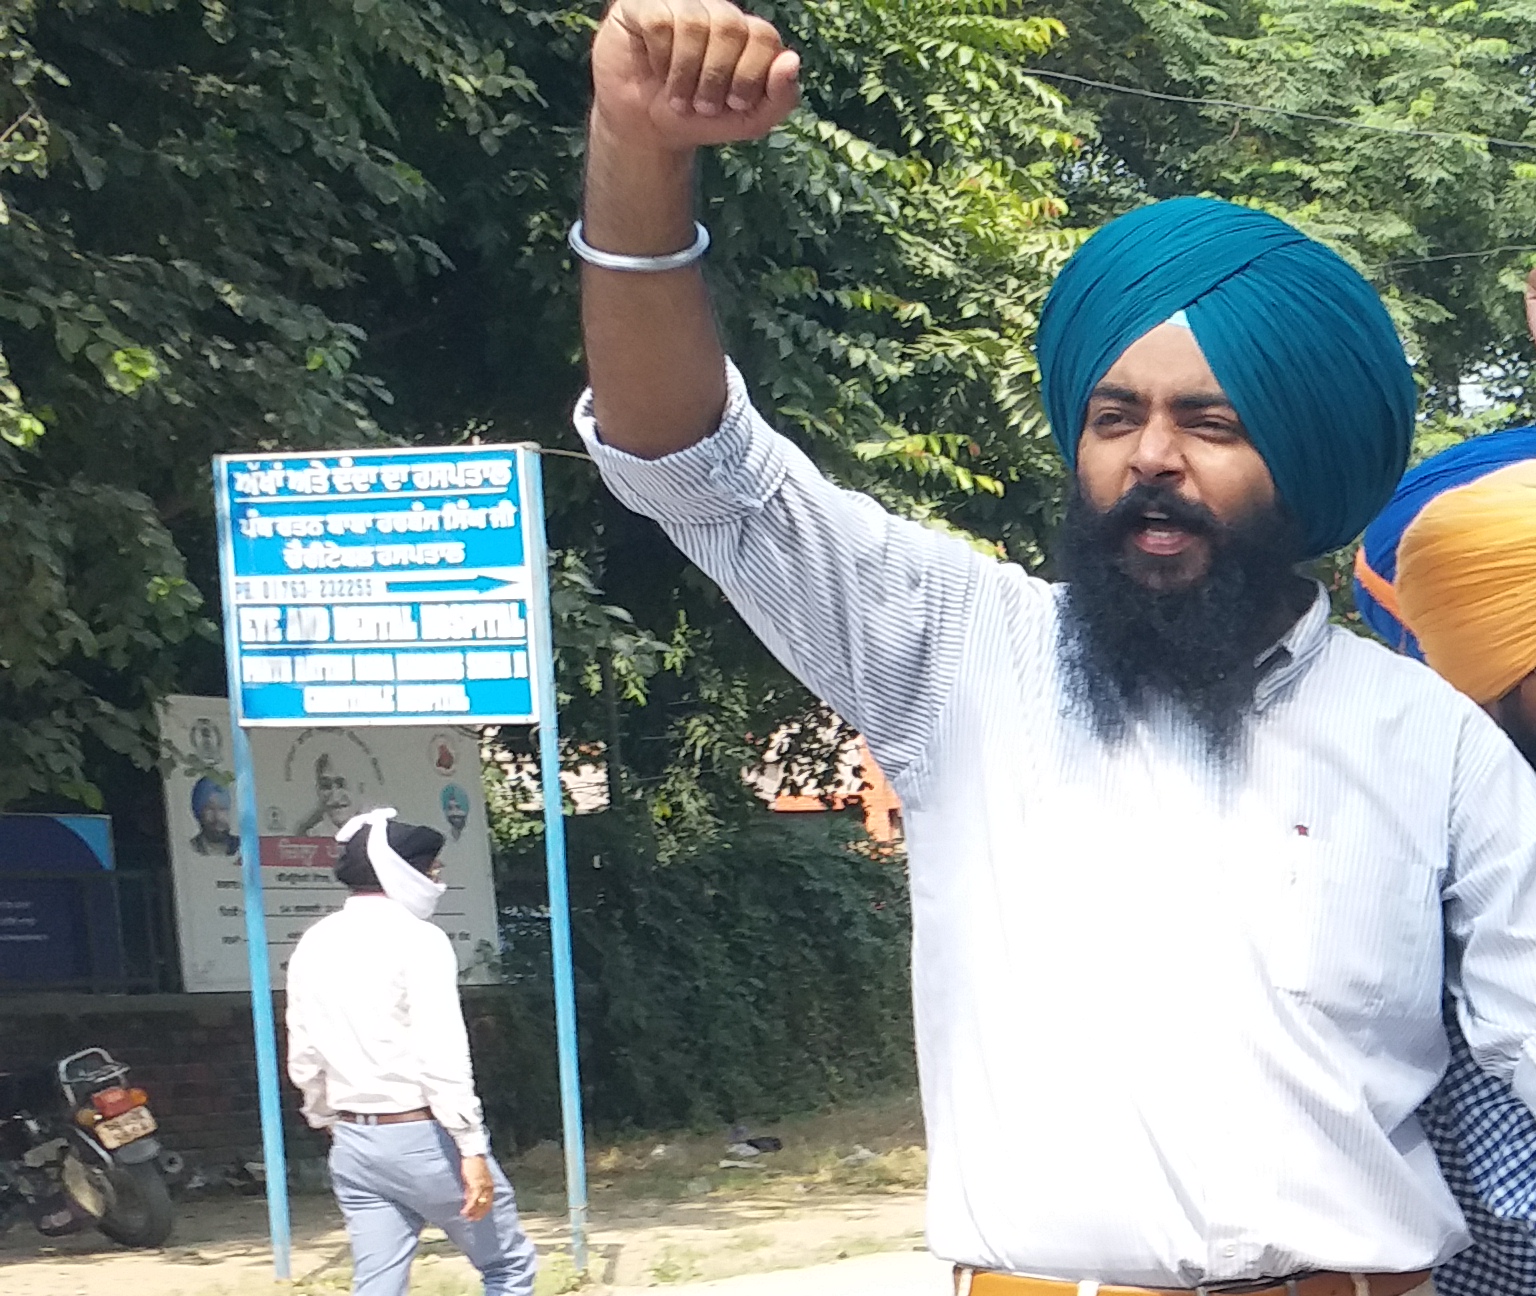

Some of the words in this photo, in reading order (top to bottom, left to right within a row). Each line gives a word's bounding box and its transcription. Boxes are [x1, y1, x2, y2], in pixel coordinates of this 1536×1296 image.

[286, 459, 331, 494] ਅਤੇ
[380, 464, 411, 491] ਦਾ
[411, 459, 512, 490] ਹਸਪਤਾਲ
[375, 541, 465, 567] ਹਸਪਤਾਲ
[240, 607, 281, 642] EYE
